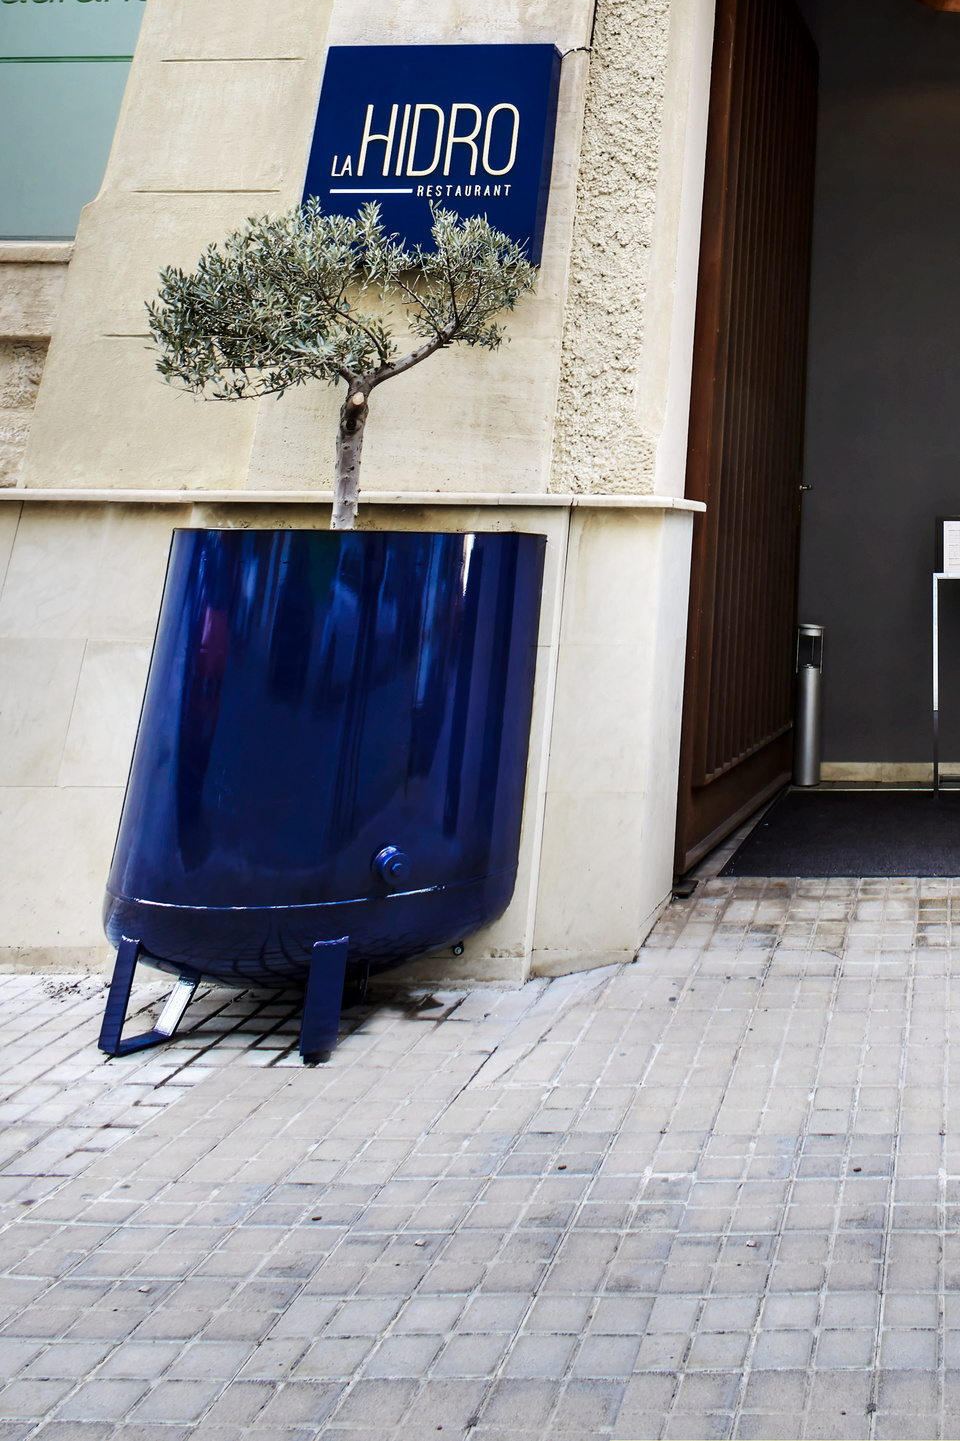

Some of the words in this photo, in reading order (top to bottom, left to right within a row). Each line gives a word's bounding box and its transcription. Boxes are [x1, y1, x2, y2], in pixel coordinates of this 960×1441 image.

[331, 155, 352, 177] LA
[356, 103, 520, 177] HIDRO
[416, 184, 512, 197] RESTAURANT
